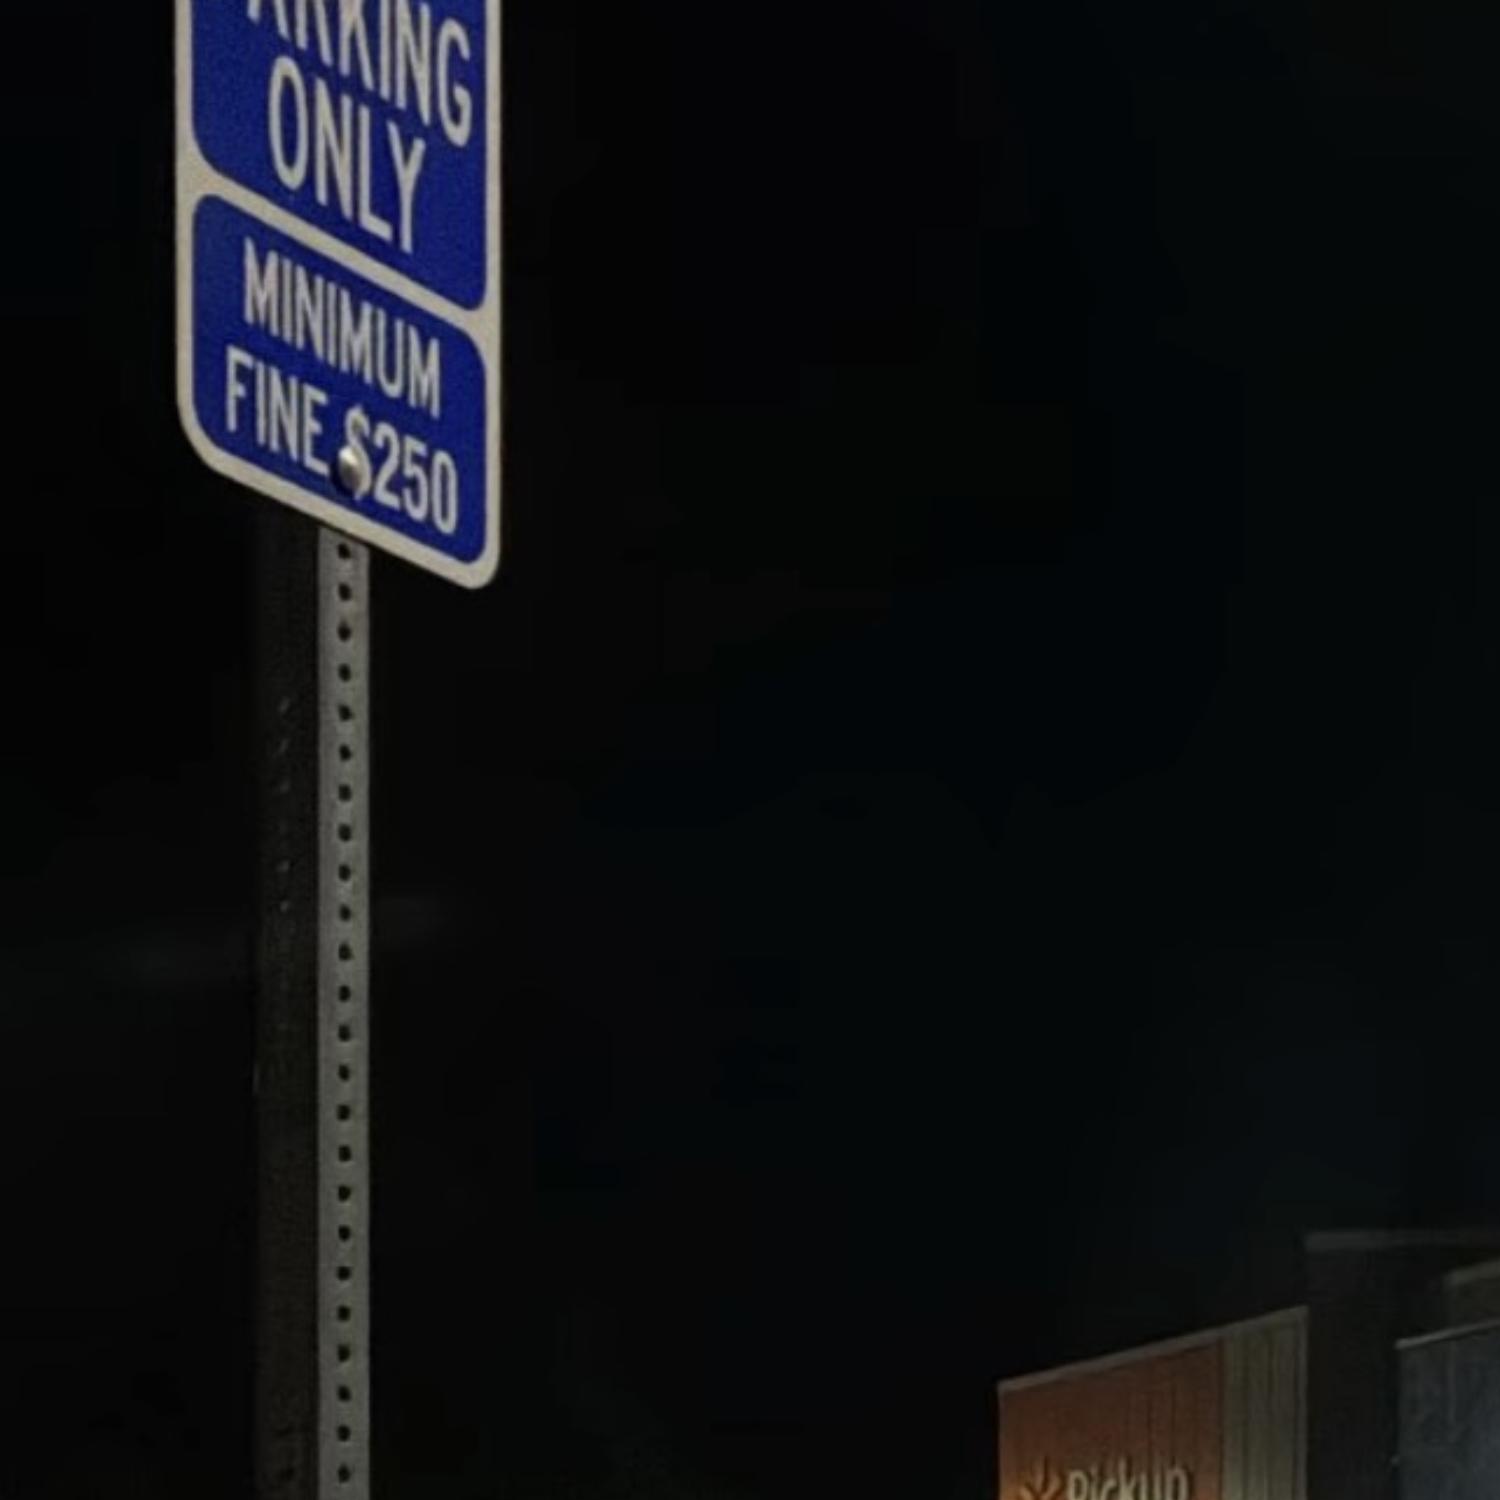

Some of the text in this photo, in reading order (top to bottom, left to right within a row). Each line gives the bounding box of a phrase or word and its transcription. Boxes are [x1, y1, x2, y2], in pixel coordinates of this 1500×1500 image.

[267, 55, 427, 254] ONLY
[243, 236, 440, 419] MINIMUM
[225, 344, 459, 535] FINE $250
